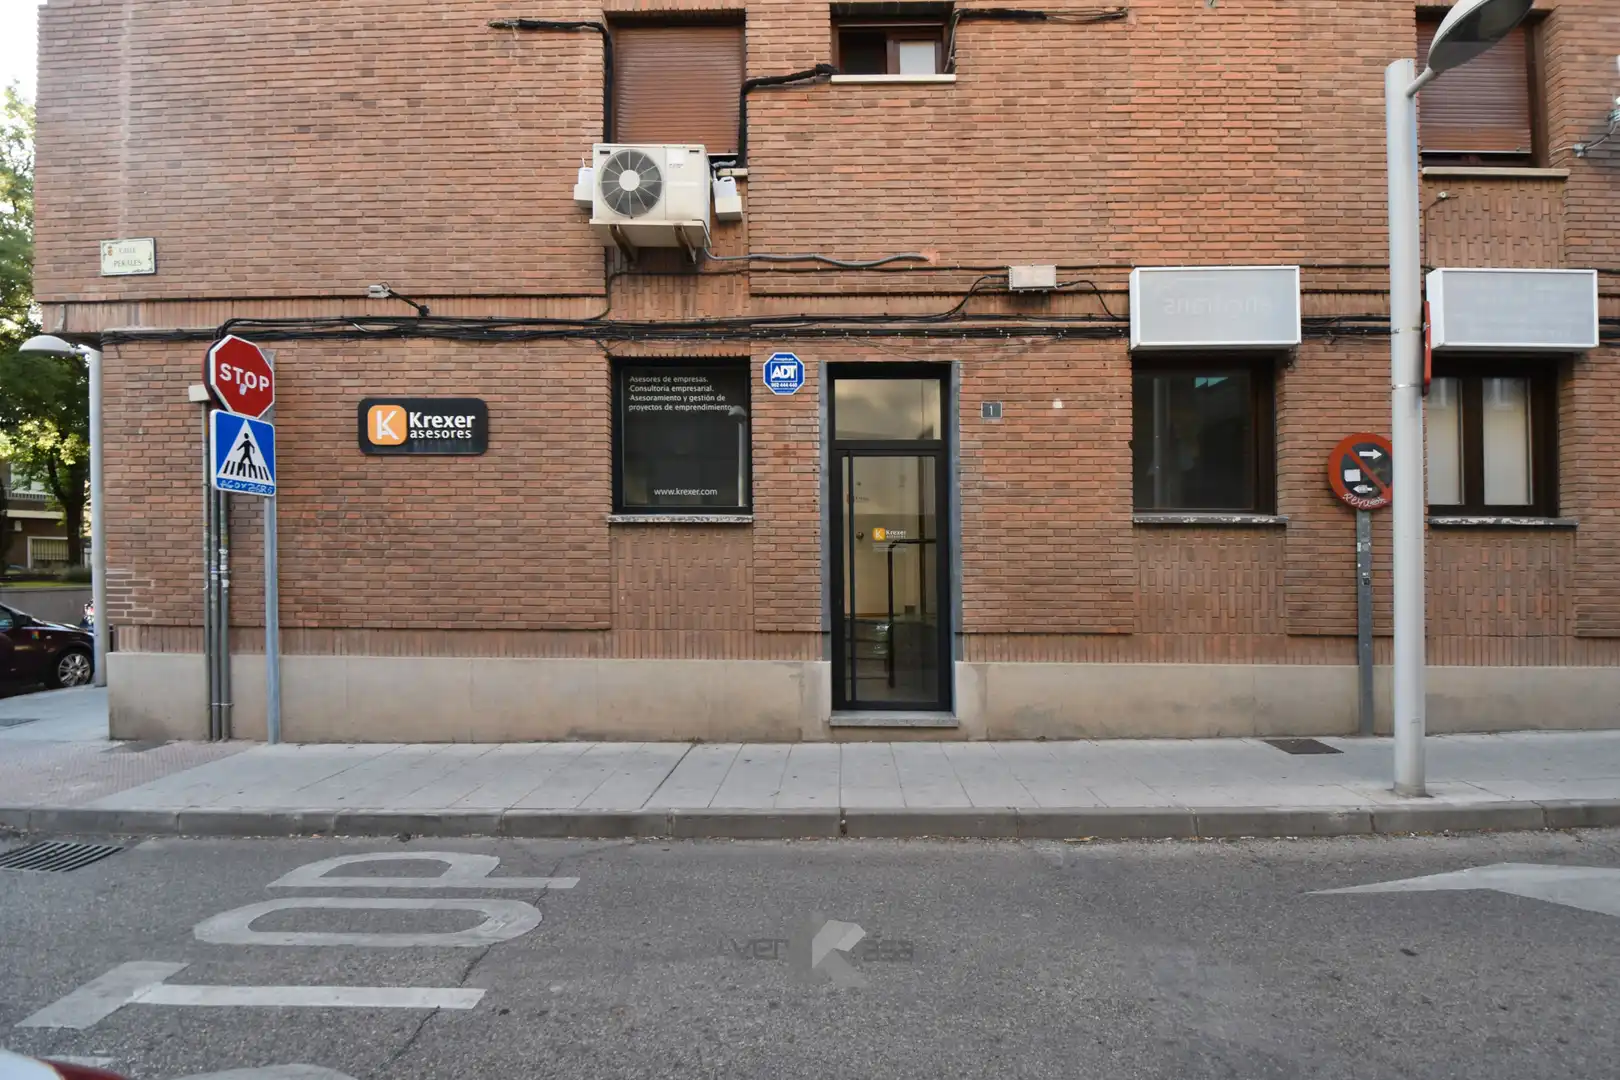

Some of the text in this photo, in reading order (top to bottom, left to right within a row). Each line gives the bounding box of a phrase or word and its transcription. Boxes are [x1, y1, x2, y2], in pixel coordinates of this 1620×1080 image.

[771, 365, 797, 379] ADT
[219, 363, 270, 392] STOP
[672, 385, 714, 393] empresarial.
[664, 403, 673, 411] de
[410, 412, 475, 428] Krexer
[410, 429, 472, 439] asesores
[654, 488, 718, 496] www.krexer.com
